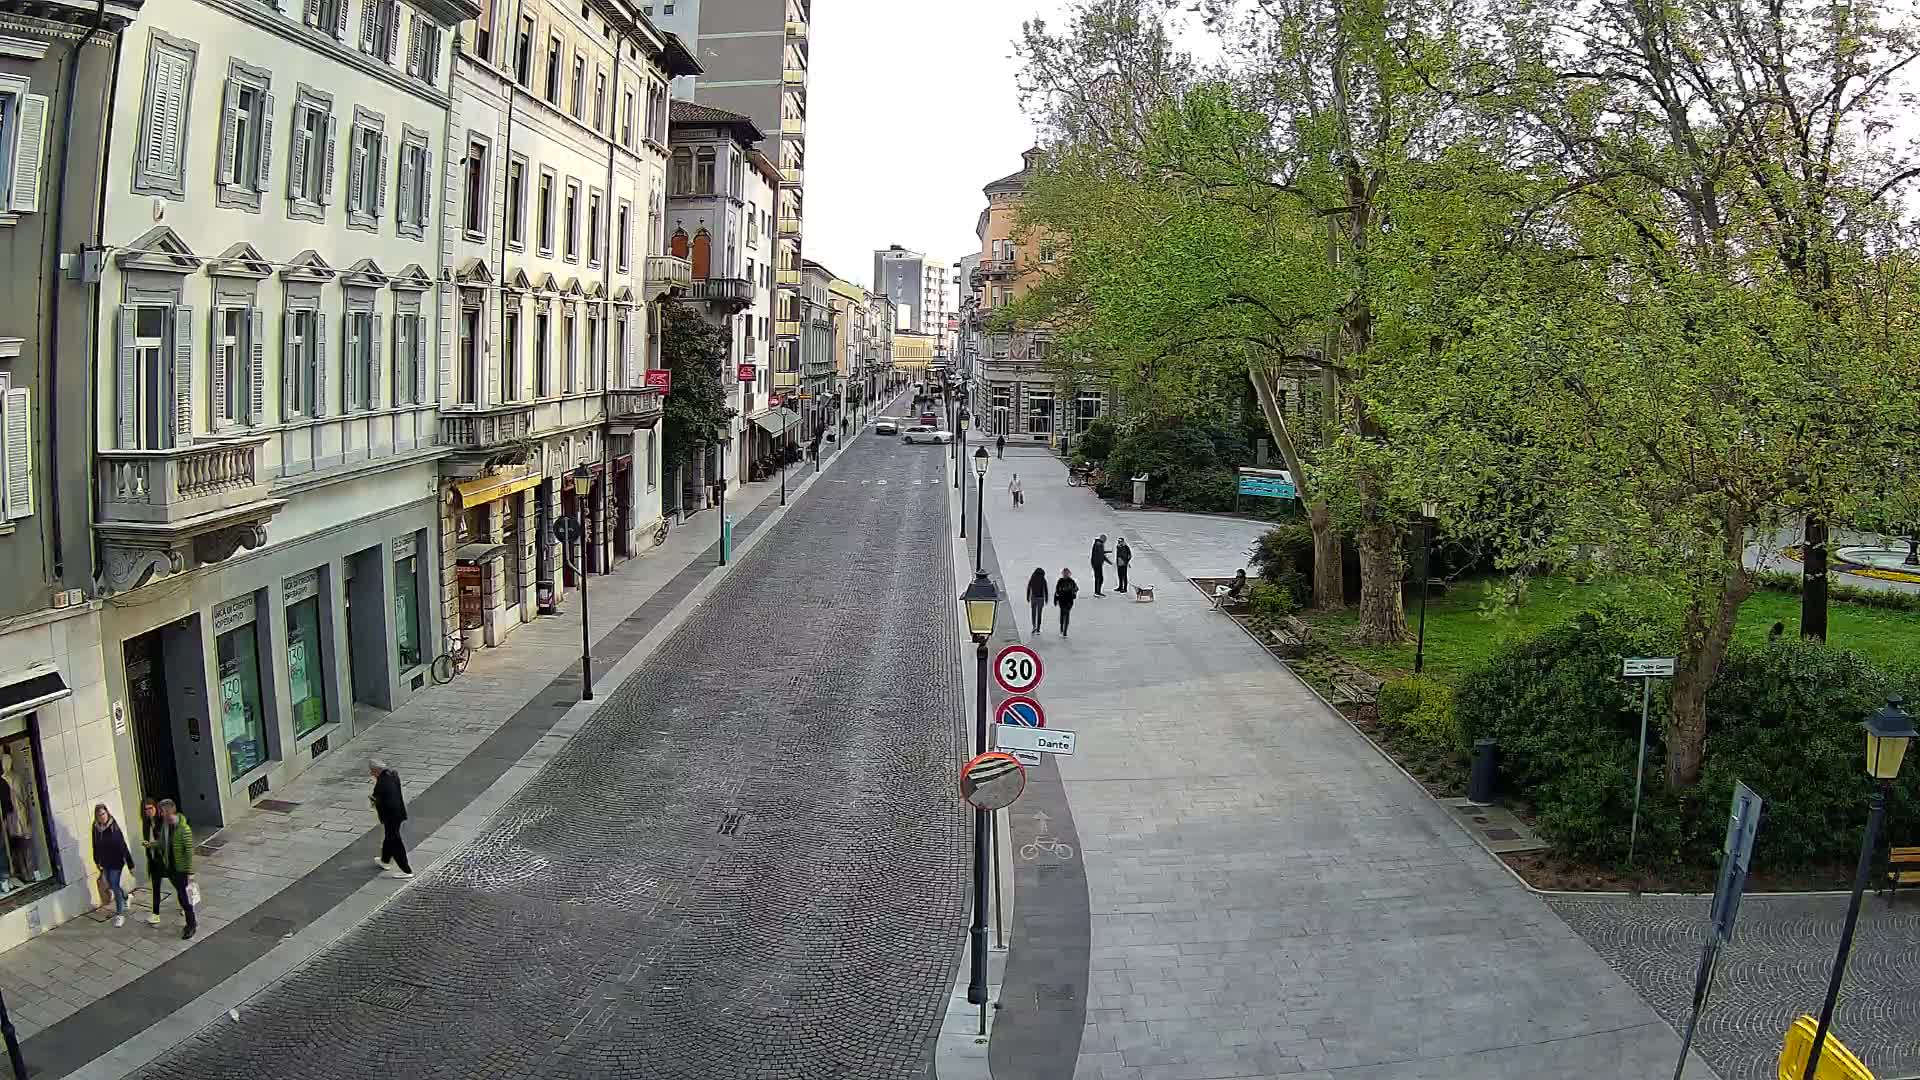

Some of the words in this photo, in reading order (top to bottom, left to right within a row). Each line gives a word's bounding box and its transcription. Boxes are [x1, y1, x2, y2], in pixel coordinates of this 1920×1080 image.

[1005, 658, 1033, 681] 30
[222, 677, 240, 700] 130
[1038, 738, 1070, 750] Dante
